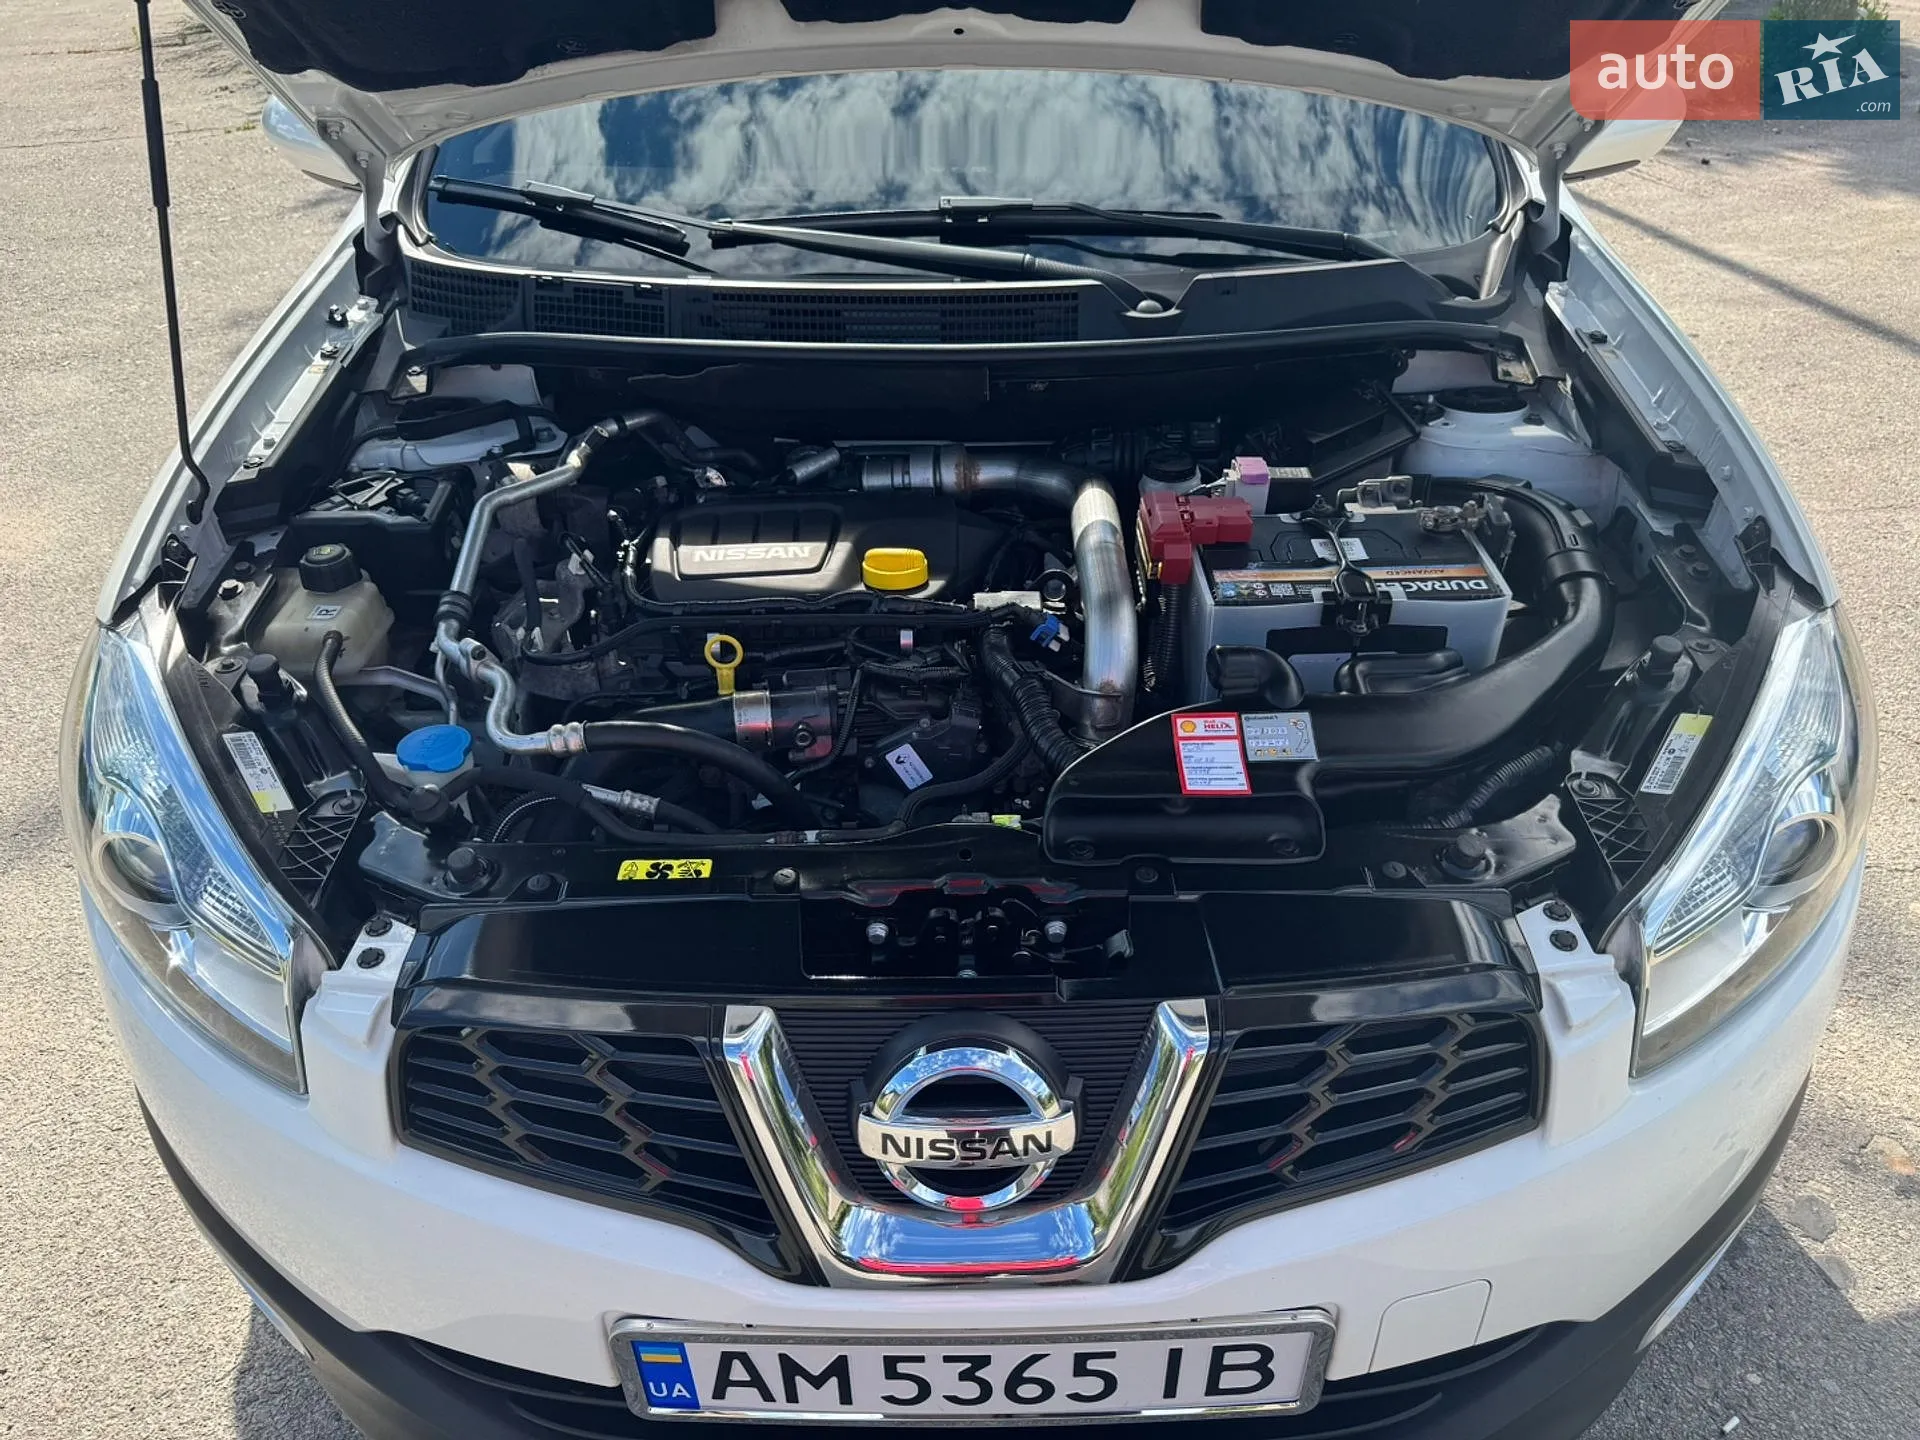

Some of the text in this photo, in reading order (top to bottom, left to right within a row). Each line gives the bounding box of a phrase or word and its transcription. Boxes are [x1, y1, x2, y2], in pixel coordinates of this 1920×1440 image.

[692, 546, 813, 562] NISSAN
[881, 1130, 1054, 1161] NISSAN
[711, 1342, 1275, 1407] AM 5365 IB
[649, 1381, 692, 1399] UA
